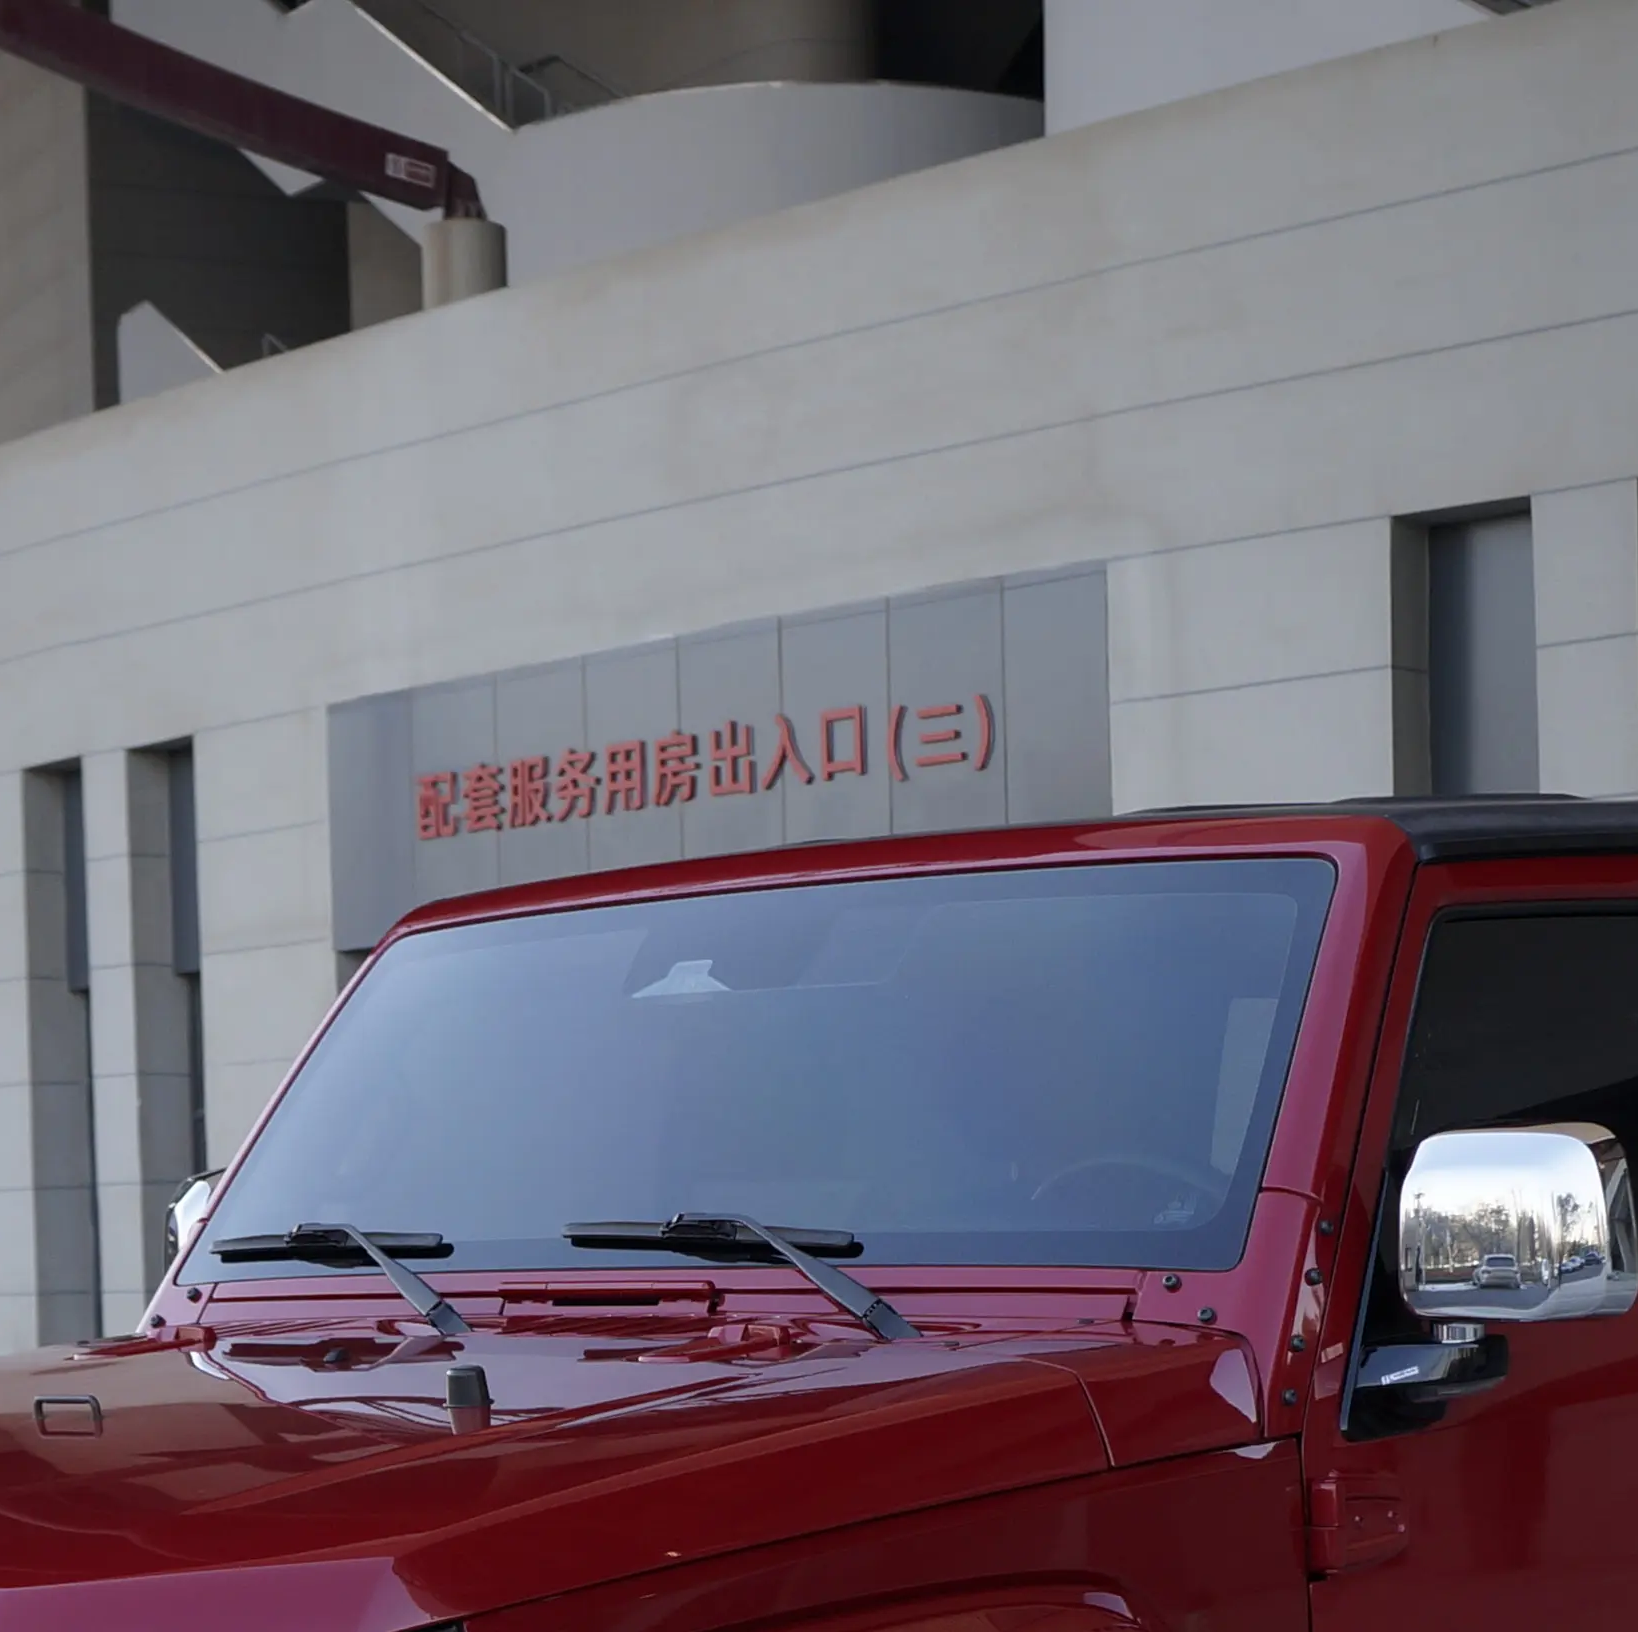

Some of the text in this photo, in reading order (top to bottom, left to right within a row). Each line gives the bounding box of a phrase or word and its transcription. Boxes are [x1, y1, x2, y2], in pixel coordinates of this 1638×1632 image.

[418, 694, 994, 841] 配套服务用房出入口(三)
